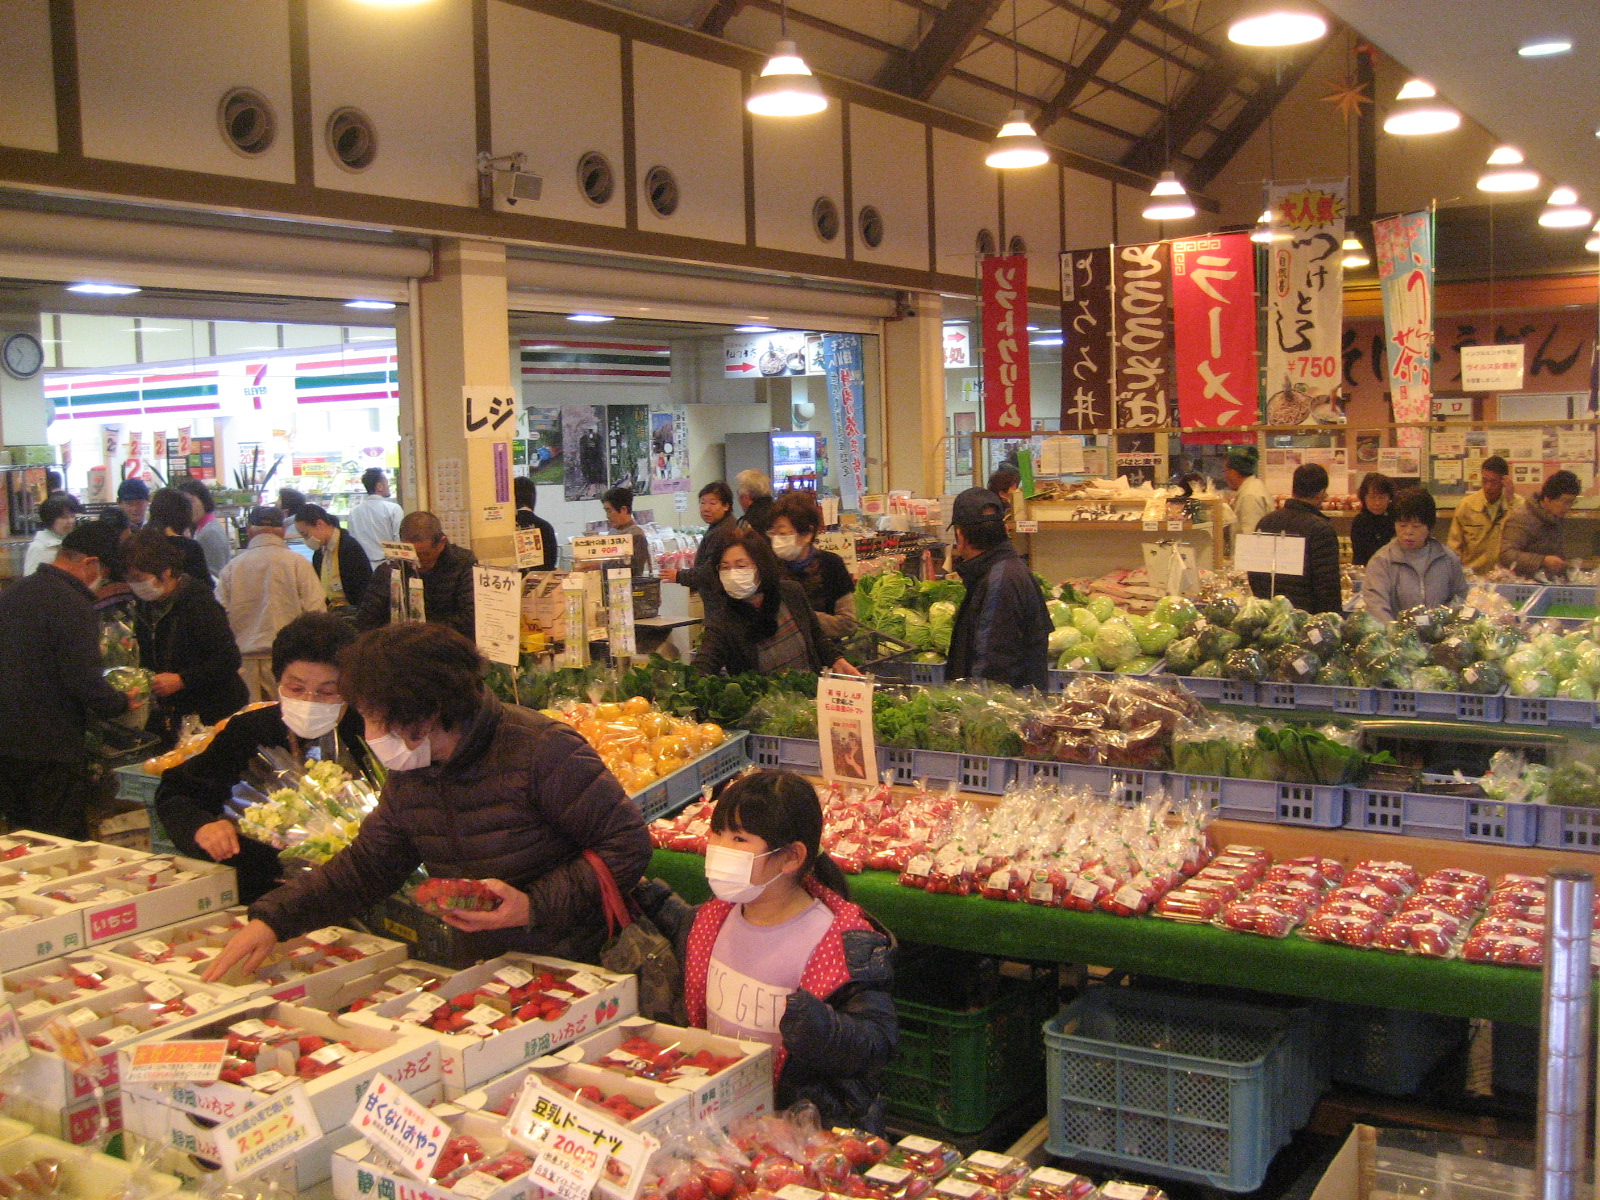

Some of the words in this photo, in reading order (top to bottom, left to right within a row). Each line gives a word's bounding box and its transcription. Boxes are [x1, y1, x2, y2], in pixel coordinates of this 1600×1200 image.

[466, 396, 514, 431] レジ
[480, 573, 515, 591] はるか
[736, 983, 783, 1028] GET
[236, 1113, 295, 1154] スコーン
[365, 1092, 437, 1158] 甘くないおやつ
[531, 1095, 623, 1154] 豆乳ドーナツ
[553, 1134, 599, 1169] 200円
